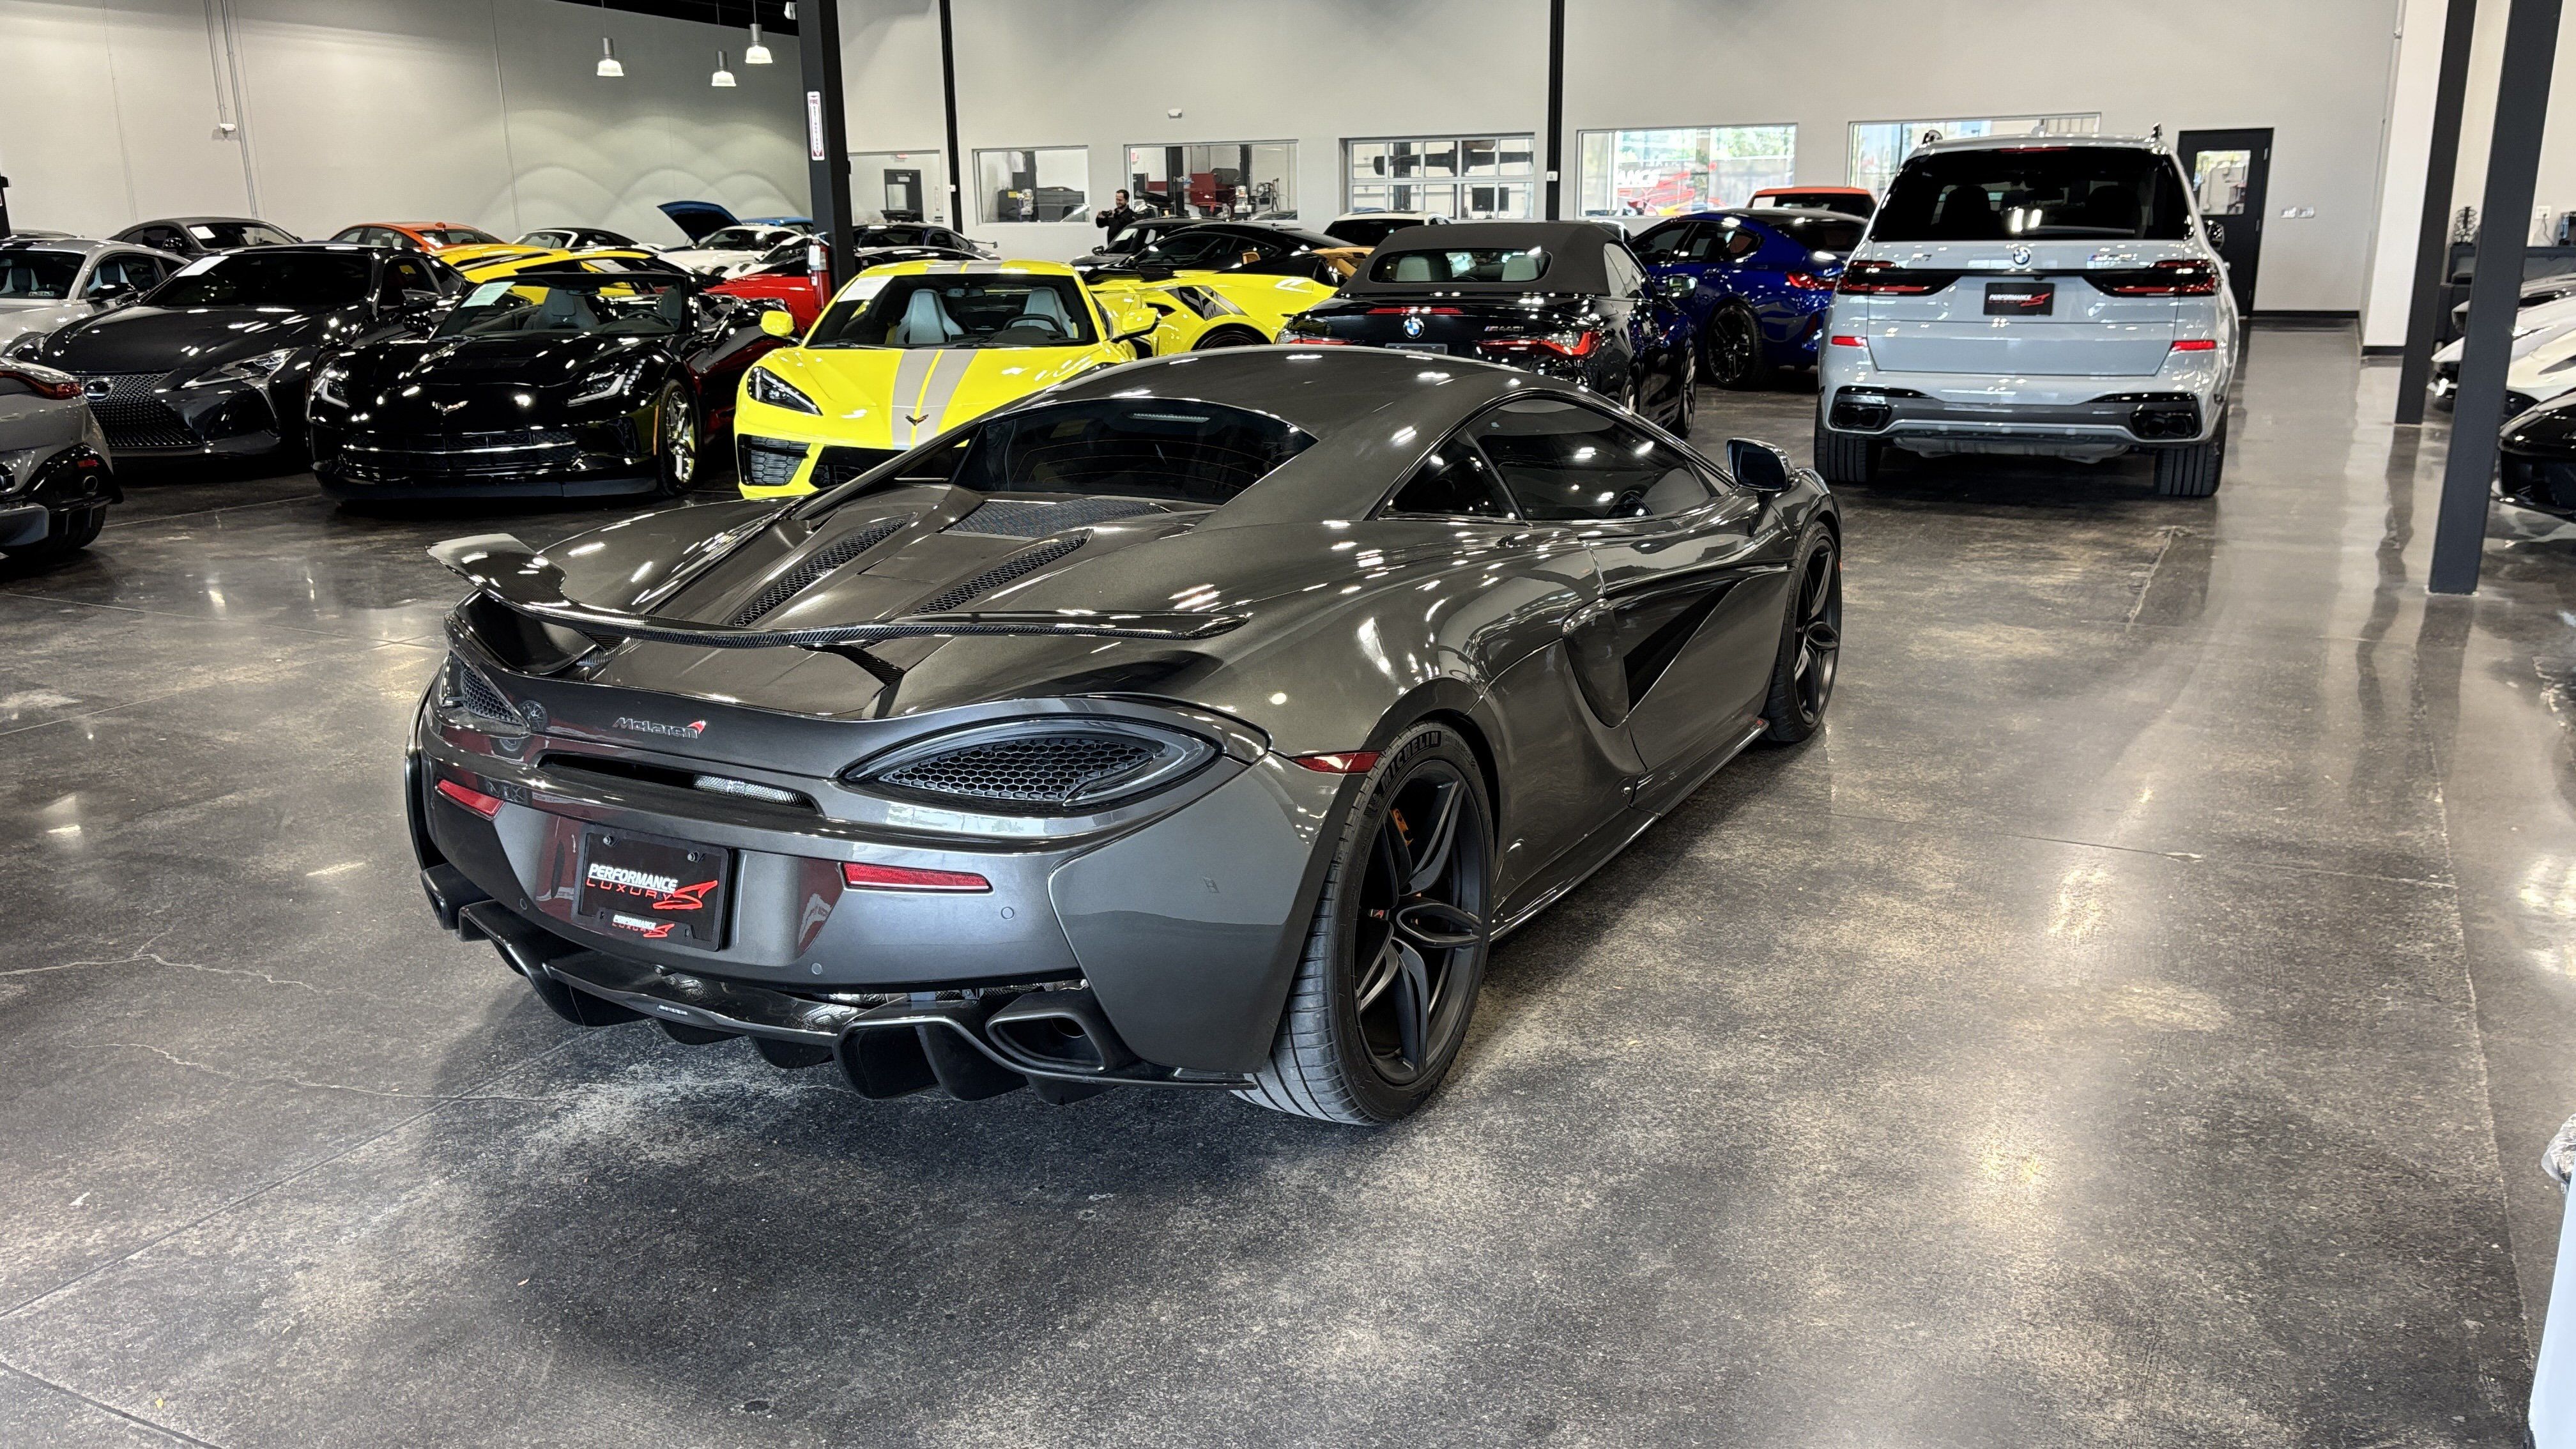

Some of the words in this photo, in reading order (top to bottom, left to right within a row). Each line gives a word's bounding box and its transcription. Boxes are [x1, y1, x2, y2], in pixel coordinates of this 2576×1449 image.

[612, 717, 698, 739] McLaren
[1381, 732, 1439, 792] MICHELIN
[586, 878, 671, 901] LUXURY
[588, 863, 678, 892] PERFORMANCE
